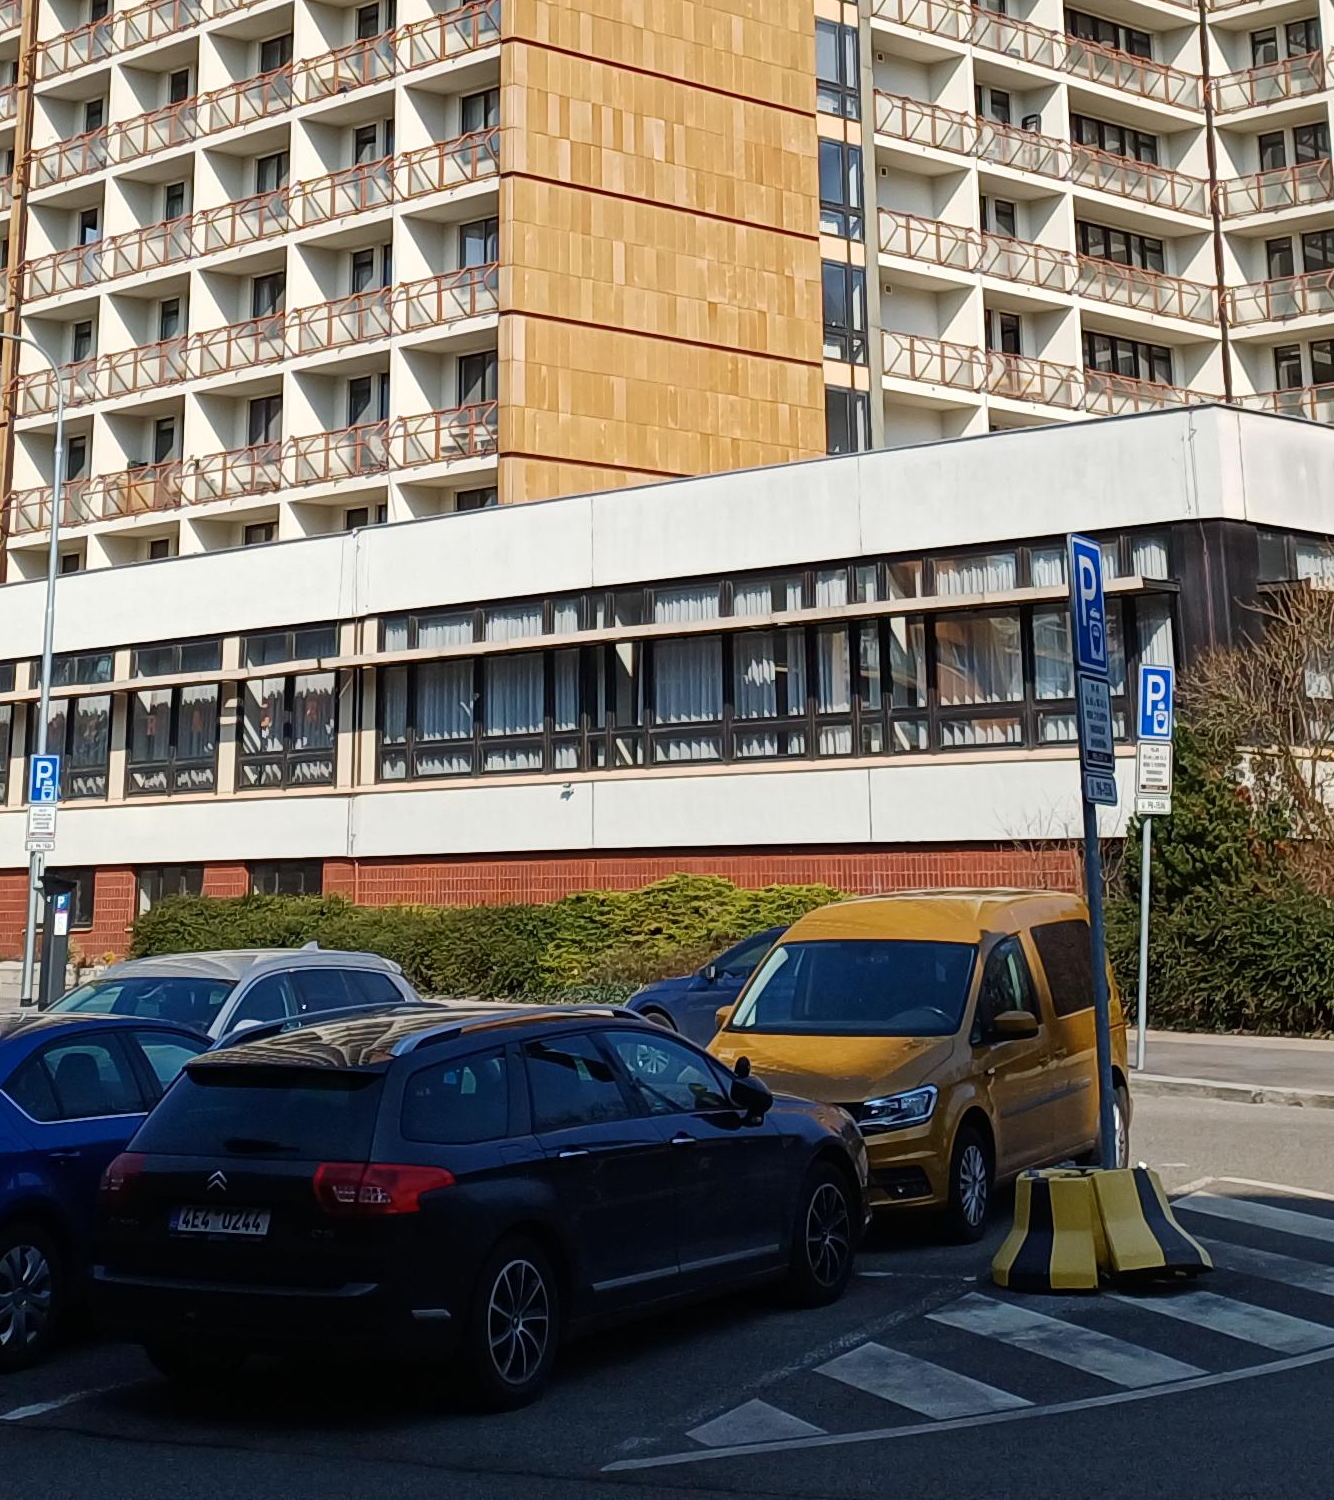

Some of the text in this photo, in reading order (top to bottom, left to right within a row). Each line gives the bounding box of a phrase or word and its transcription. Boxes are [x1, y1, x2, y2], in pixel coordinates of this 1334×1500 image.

[1078, 554, 1097, 627] P
[1146, 674, 1166, 716] P
[35, 760, 53, 789] P
[181, 1208, 262, 1232] 4E4 0244
